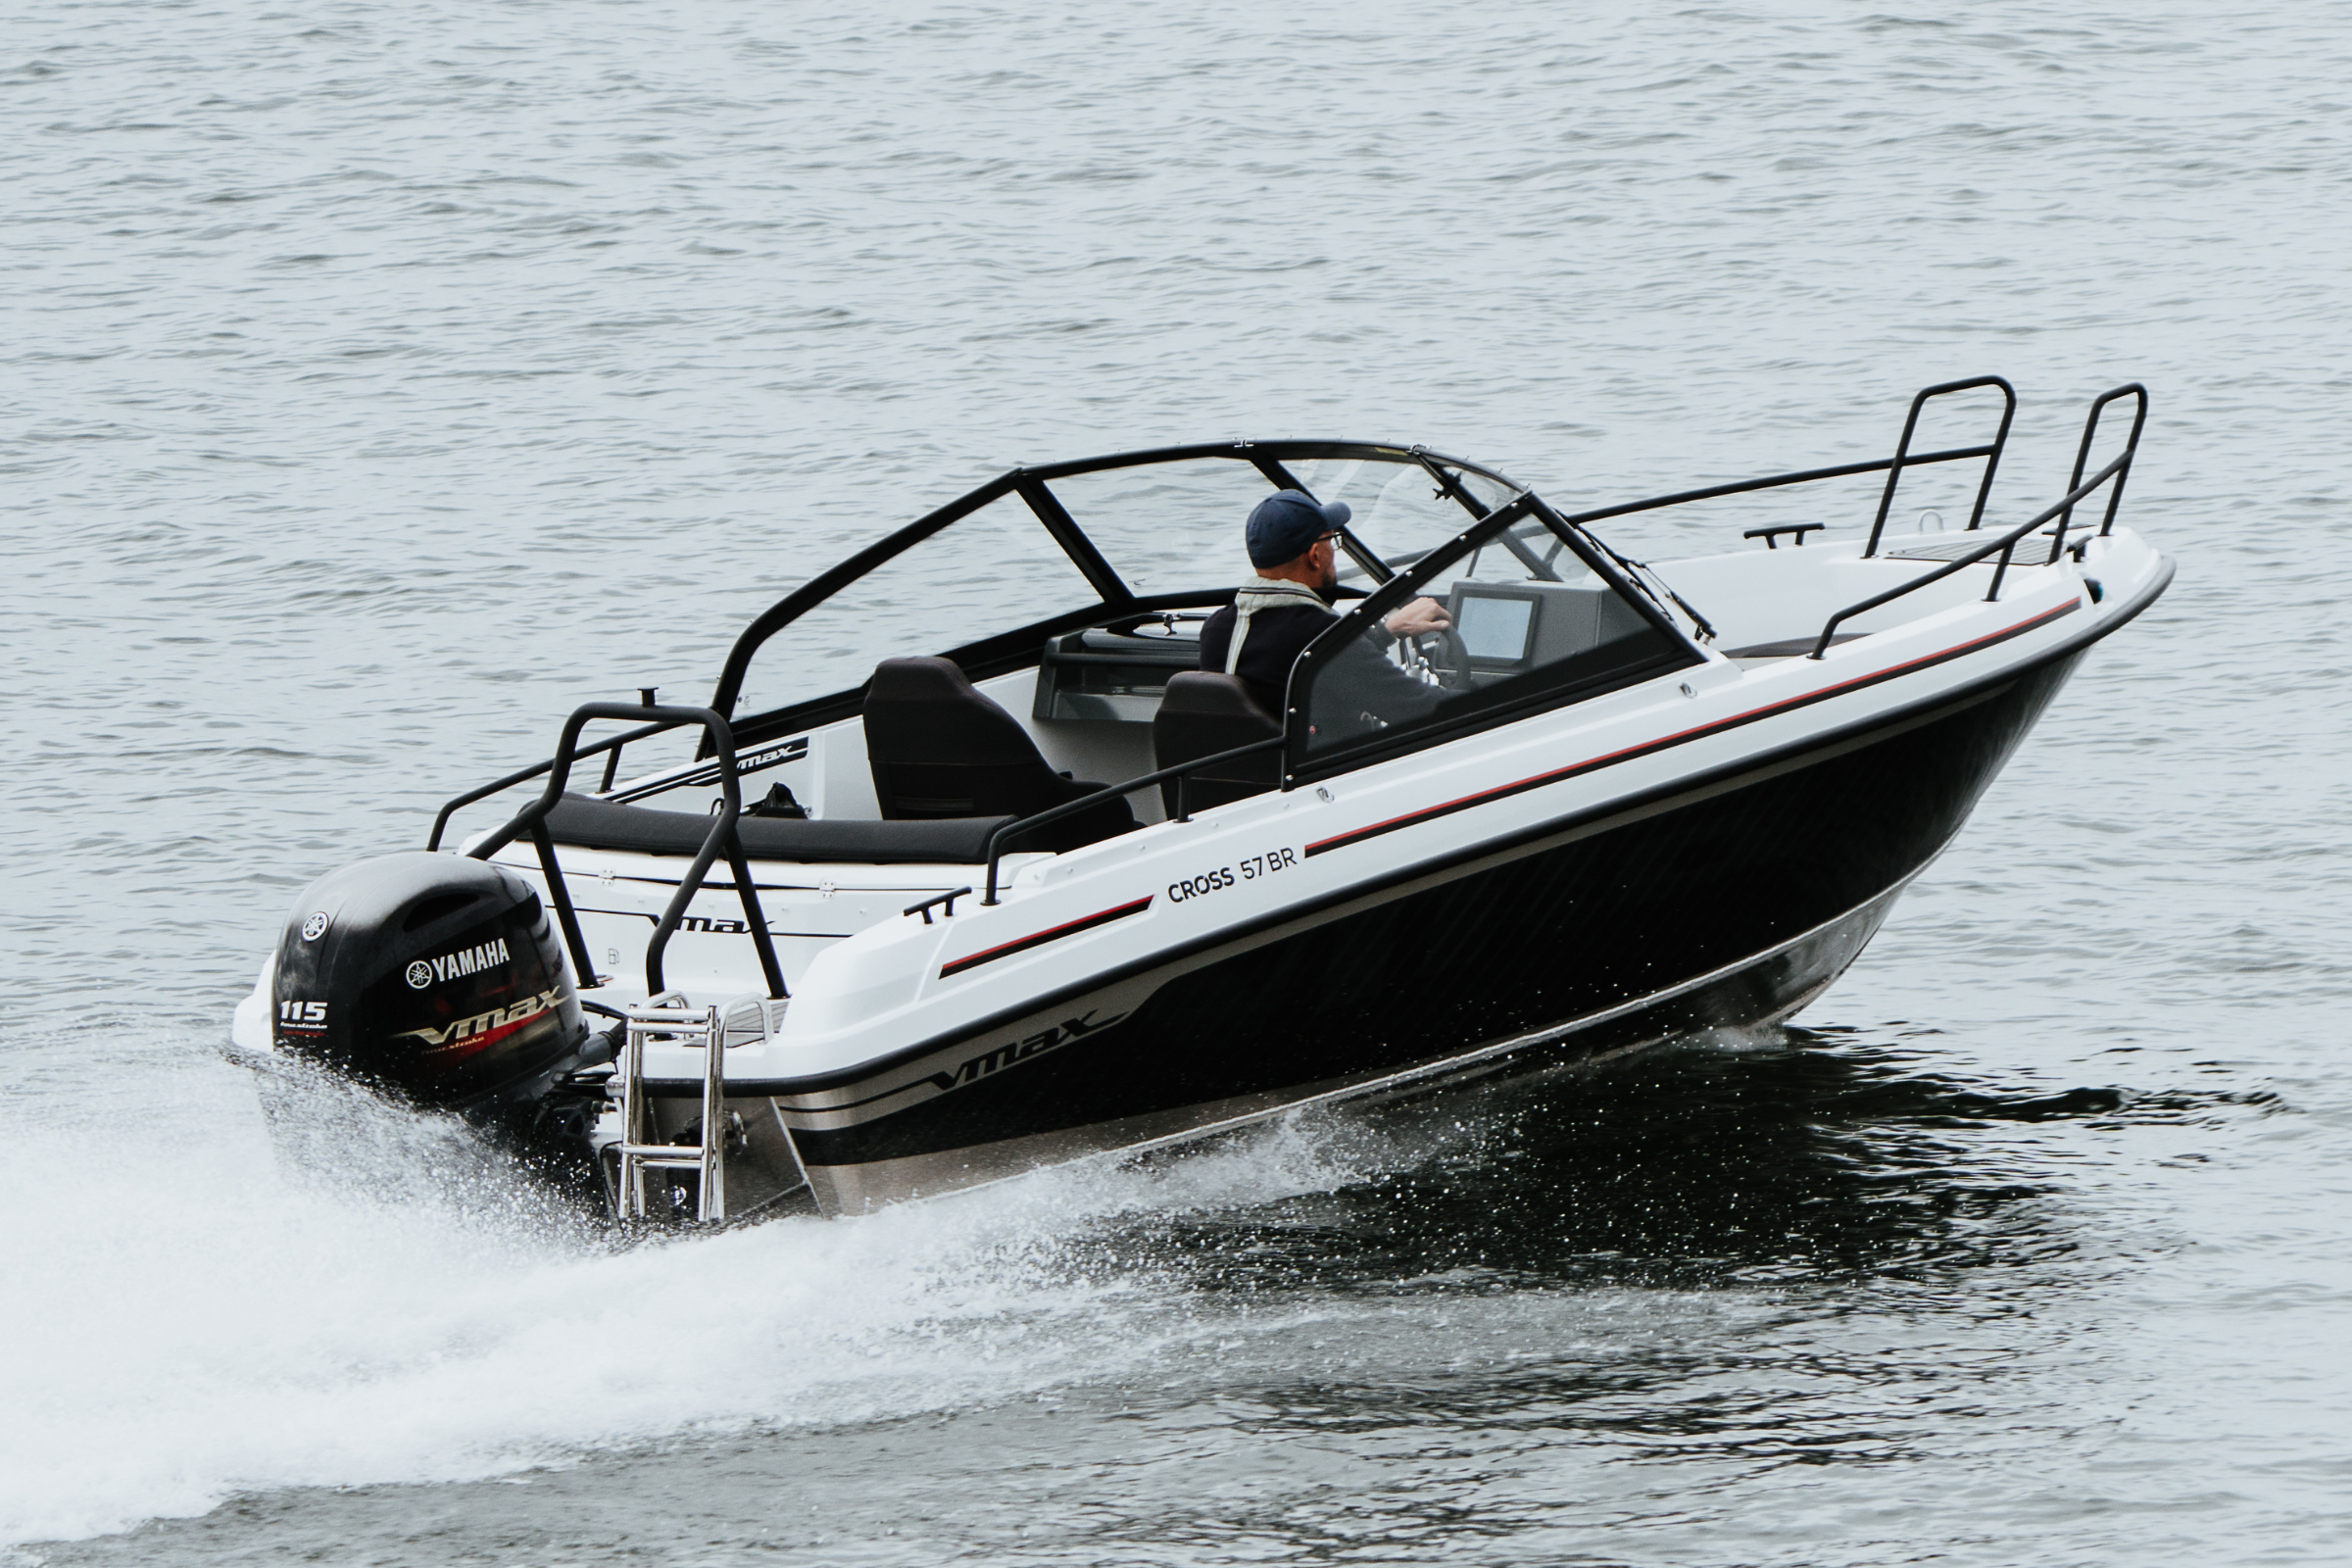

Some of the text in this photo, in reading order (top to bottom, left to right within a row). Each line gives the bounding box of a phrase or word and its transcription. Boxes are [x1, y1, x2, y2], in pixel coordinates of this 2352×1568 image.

[1168, 867, 1235, 904] CROSS
[431, 937, 511, 982] YAMAHA
[280, 1000, 328, 1021] 115
